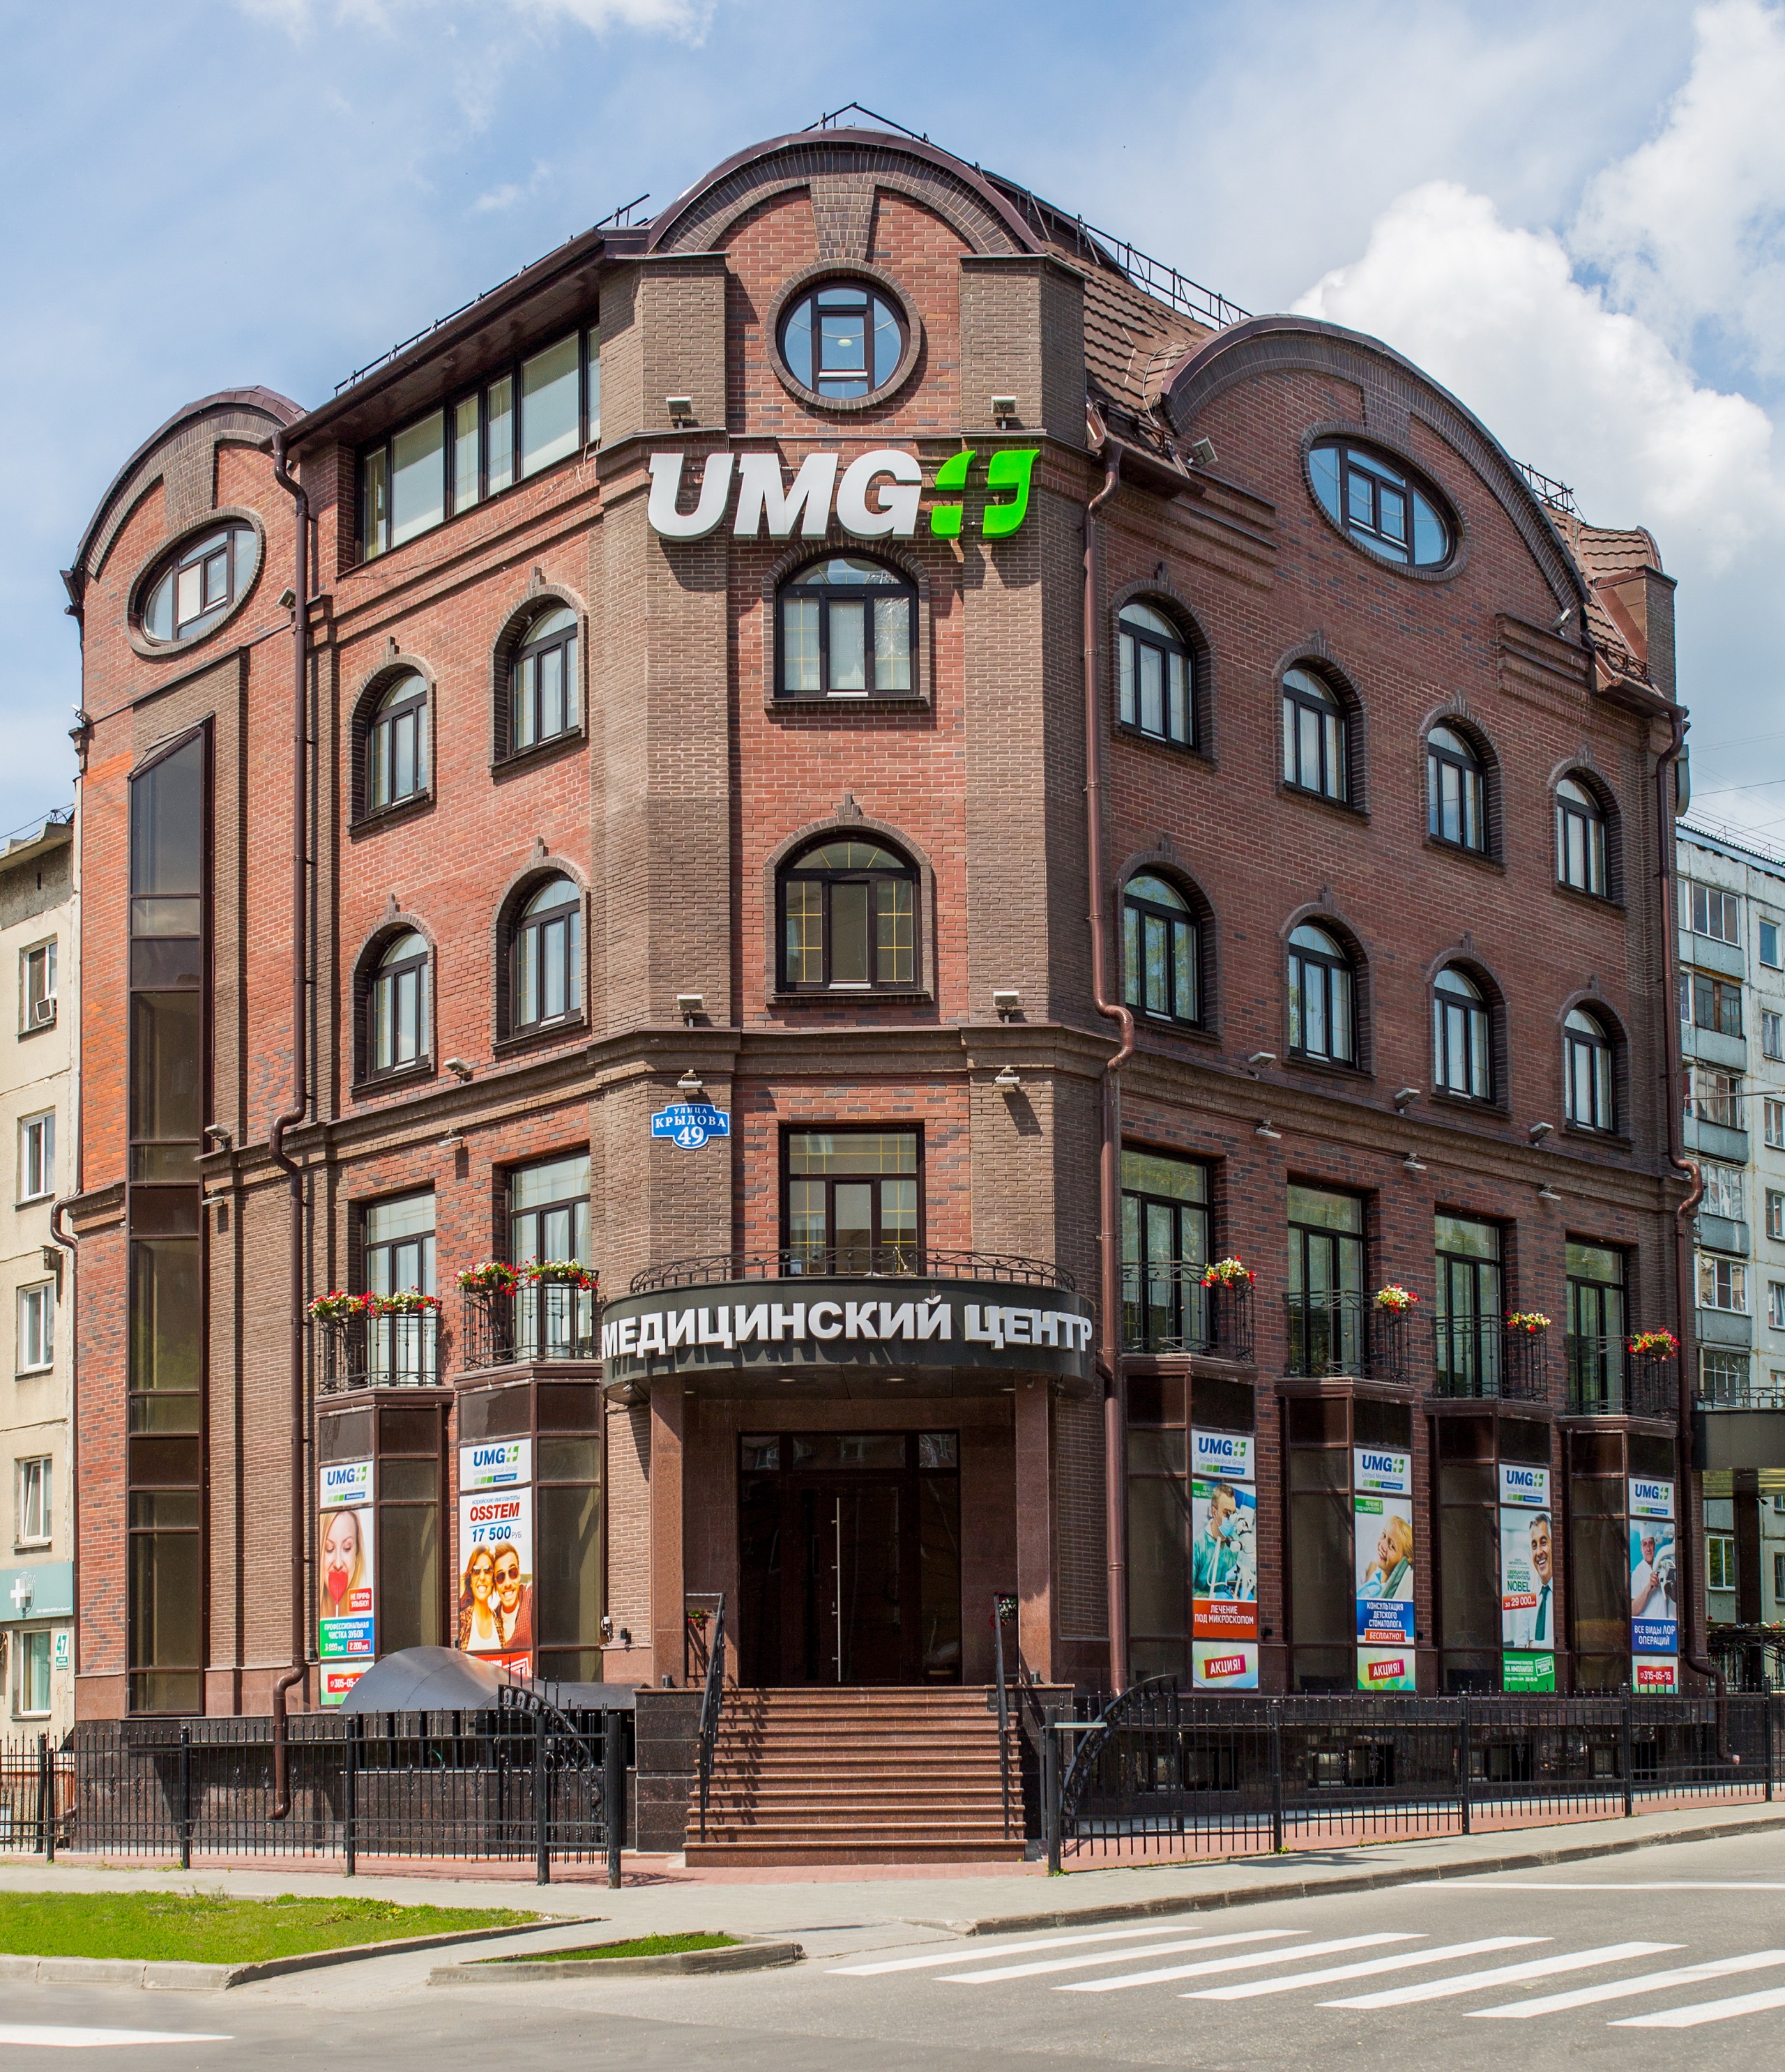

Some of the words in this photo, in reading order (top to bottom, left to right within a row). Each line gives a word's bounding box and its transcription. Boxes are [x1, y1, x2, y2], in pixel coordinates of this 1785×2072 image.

[648, 449, 922, 541] UMG
[655, 1115, 726, 1128] КРЫЛОВА
[677, 1126, 704, 1145] 49
[601, 1295, 952, 1359] МЕДИЦИНСКИЙ
[964, 1304, 1093, 1352] ЦЕНТР
[1199, 1437, 1233, 1456] UMG
[473, 1447, 505, 1467] UMG
[1362, 1454, 1392, 1472] UMG
[327, 1468, 355, 1486] UMG
[1506, 1470, 1533, 1486] UMG
[1635, 1484, 1659, 1500] UMG
[470, 1502, 520, 1521] OSSTEM
[472, 1528, 485, 1542] 17
[489, 1525, 511, 1541] 500
[1507, 1580, 1530, 1592] NOBEL
[1367, 1602, 1404, 1611] КОНСУЛЬТАЦИЯ
[1511, 1597, 1519, 1607] 29
[1520, 1595, 1532, 1605] 000
[1210, 1604, 1238, 1614] ЛЕЧЕНИЕ
[1373, 1610, 1397, 1619] ДЕТСКОГО
[324, 1621, 369, 1630] ПРОФЕССИОНАЛЬНАЯ
[1194, 1614, 1207, 1623] ПОД
[1209, 1615, 1254, 1624] МИКРОСКОПОМ
[1369, 1620, 1402, 1628] СТОМАТОЛОГА
[348, 1630, 364, 1638] ЗУБОВ
[1634, 1625, 1644, 1633] ВСЕ
[1646, 1626, 1662, 1635] ВИДЫ
[1663, 1625, 1675, 1634] ЛОР
[56, 1635, 67, 1655] 47
[1639, 1636, 1670, 1646] ОПЕРАЦИЙ
[1210, 1658, 1240, 1675] АКЦИЯ!
[1373, 1662, 1400, 1677] АКЦИЯ!
